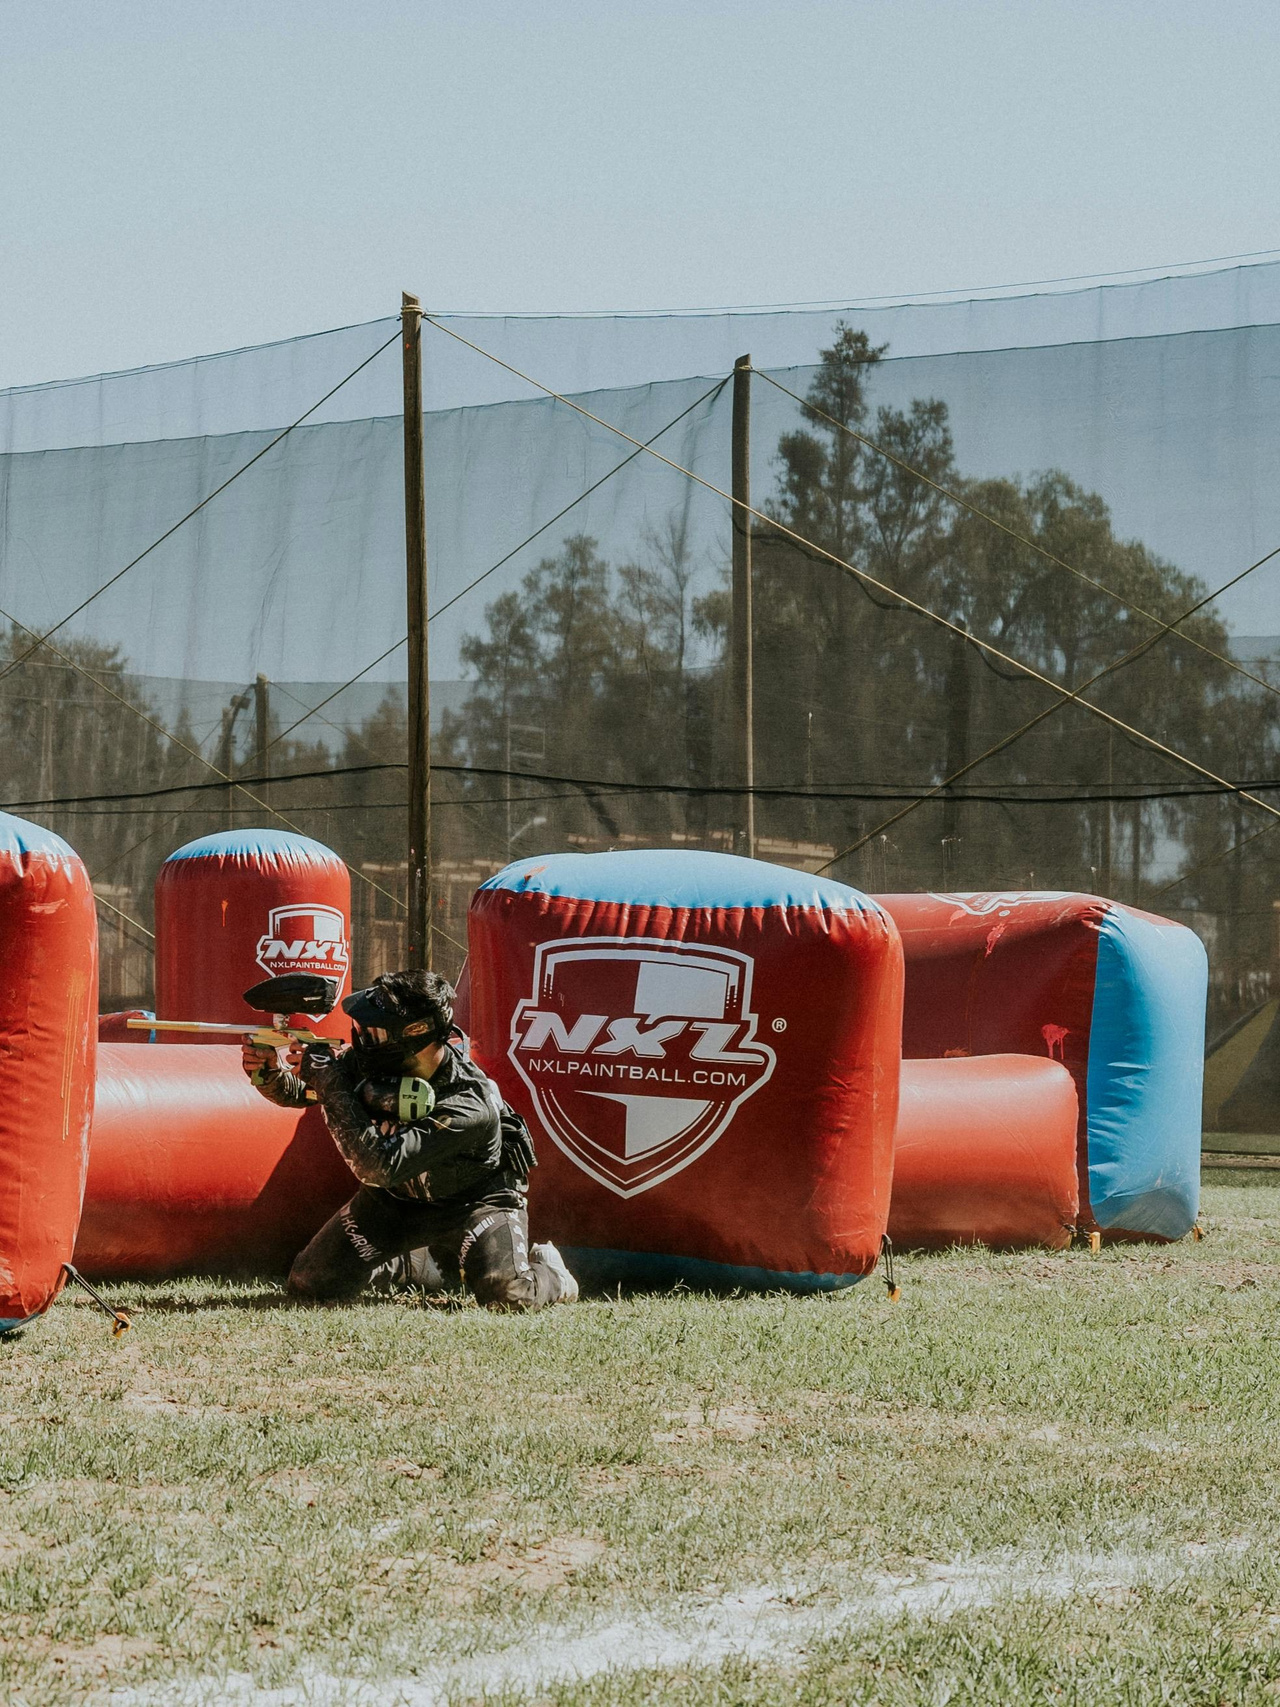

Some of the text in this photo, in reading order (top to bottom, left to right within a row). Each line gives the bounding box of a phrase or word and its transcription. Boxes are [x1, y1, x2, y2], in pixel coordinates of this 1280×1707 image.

[263, 940, 348, 962] NXL
[519, 1010, 765, 1066] NXL
[529, 1058, 746, 1087] NXLPAINTBALL.COM
